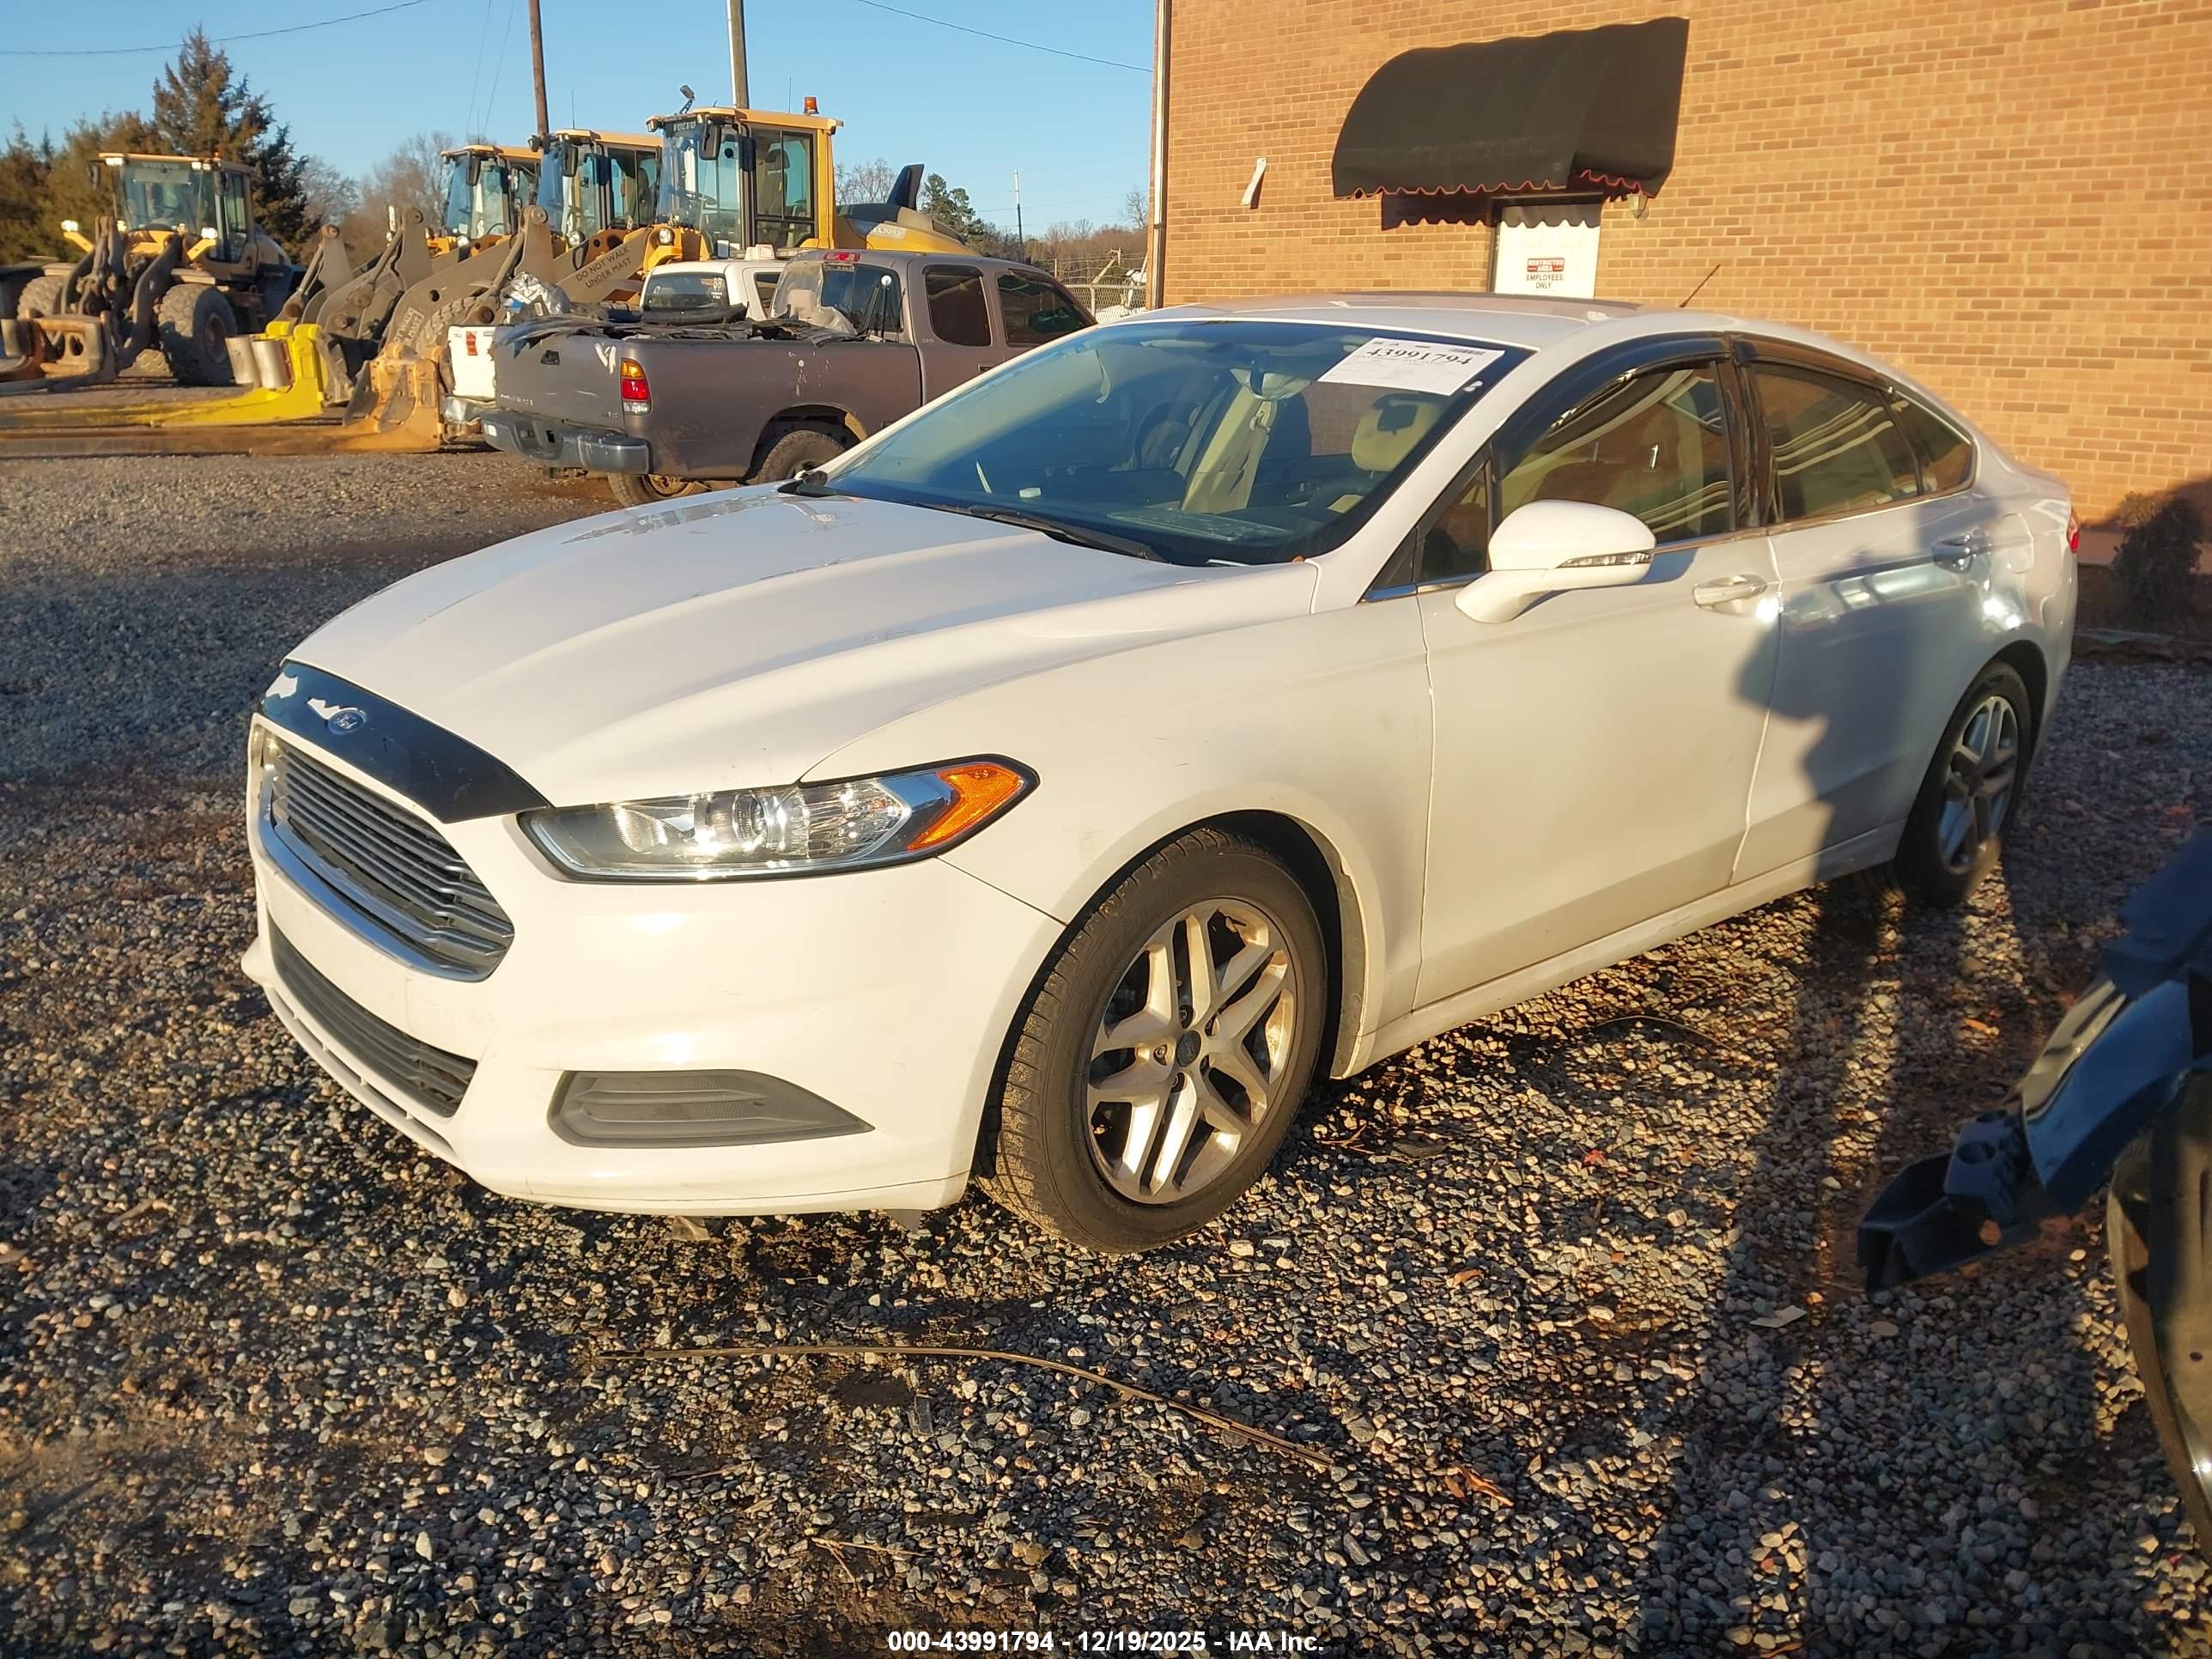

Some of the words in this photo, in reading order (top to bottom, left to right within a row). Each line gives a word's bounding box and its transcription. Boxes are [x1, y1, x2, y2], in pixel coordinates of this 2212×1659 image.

[672, 120, 696, 132] VOLVO
[575, 270, 589, 282] DO
[589, 260, 605, 274] NOT
[608, 246, 630, 263] WALK
[584, 269, 611, 289] UNDER
[611, 257, 632, 274] MAST
[1366, 347, 1474, 366] 43991794
